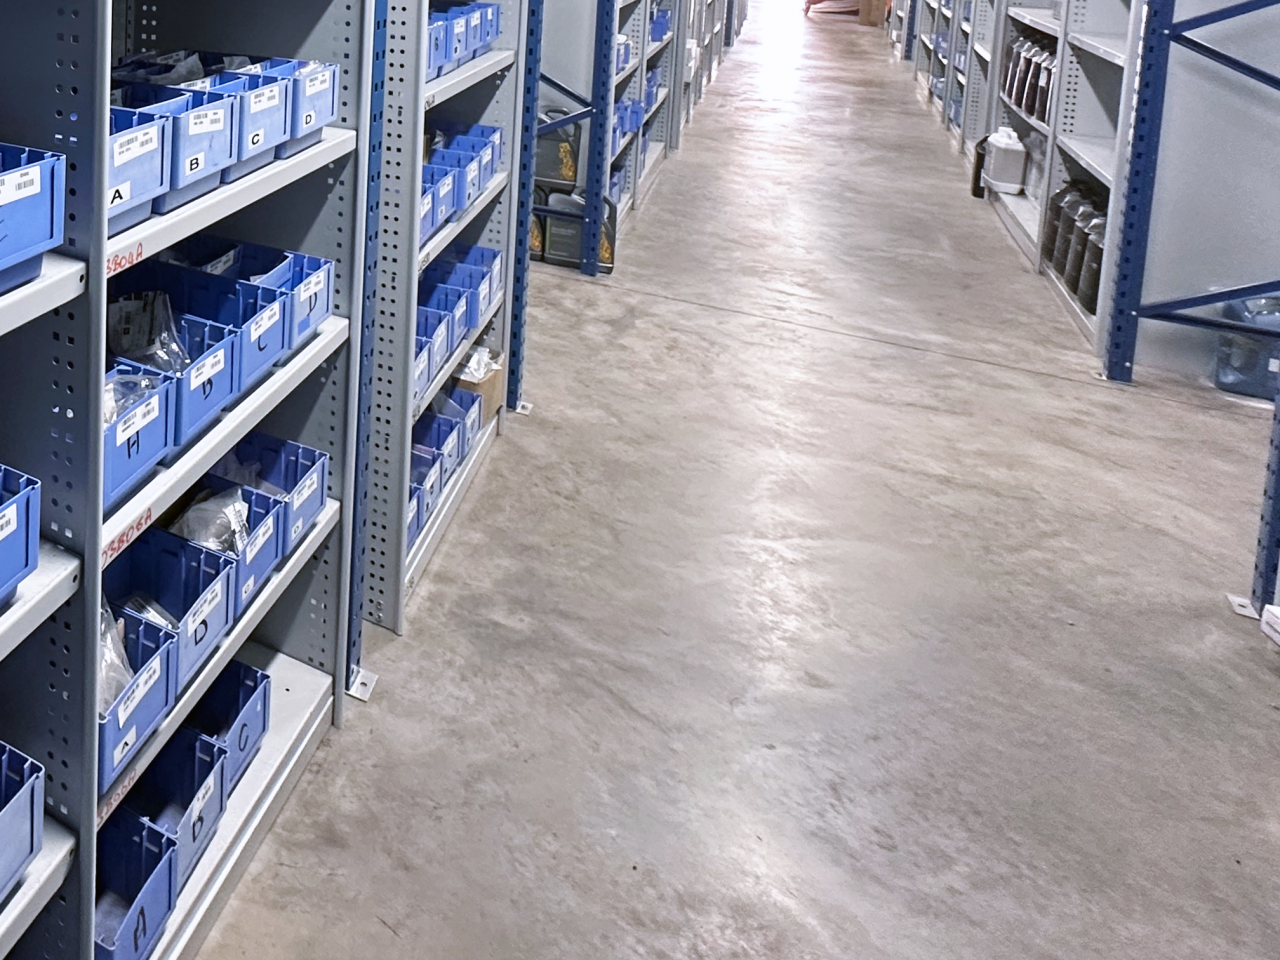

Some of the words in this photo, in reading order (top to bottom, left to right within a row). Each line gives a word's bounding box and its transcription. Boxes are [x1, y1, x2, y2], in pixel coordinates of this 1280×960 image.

[304, 113, 313, 125] D
[251, 133, 261, 146] C
[189, 157, 200, 172] B
[110, 189, 124, 205] A
